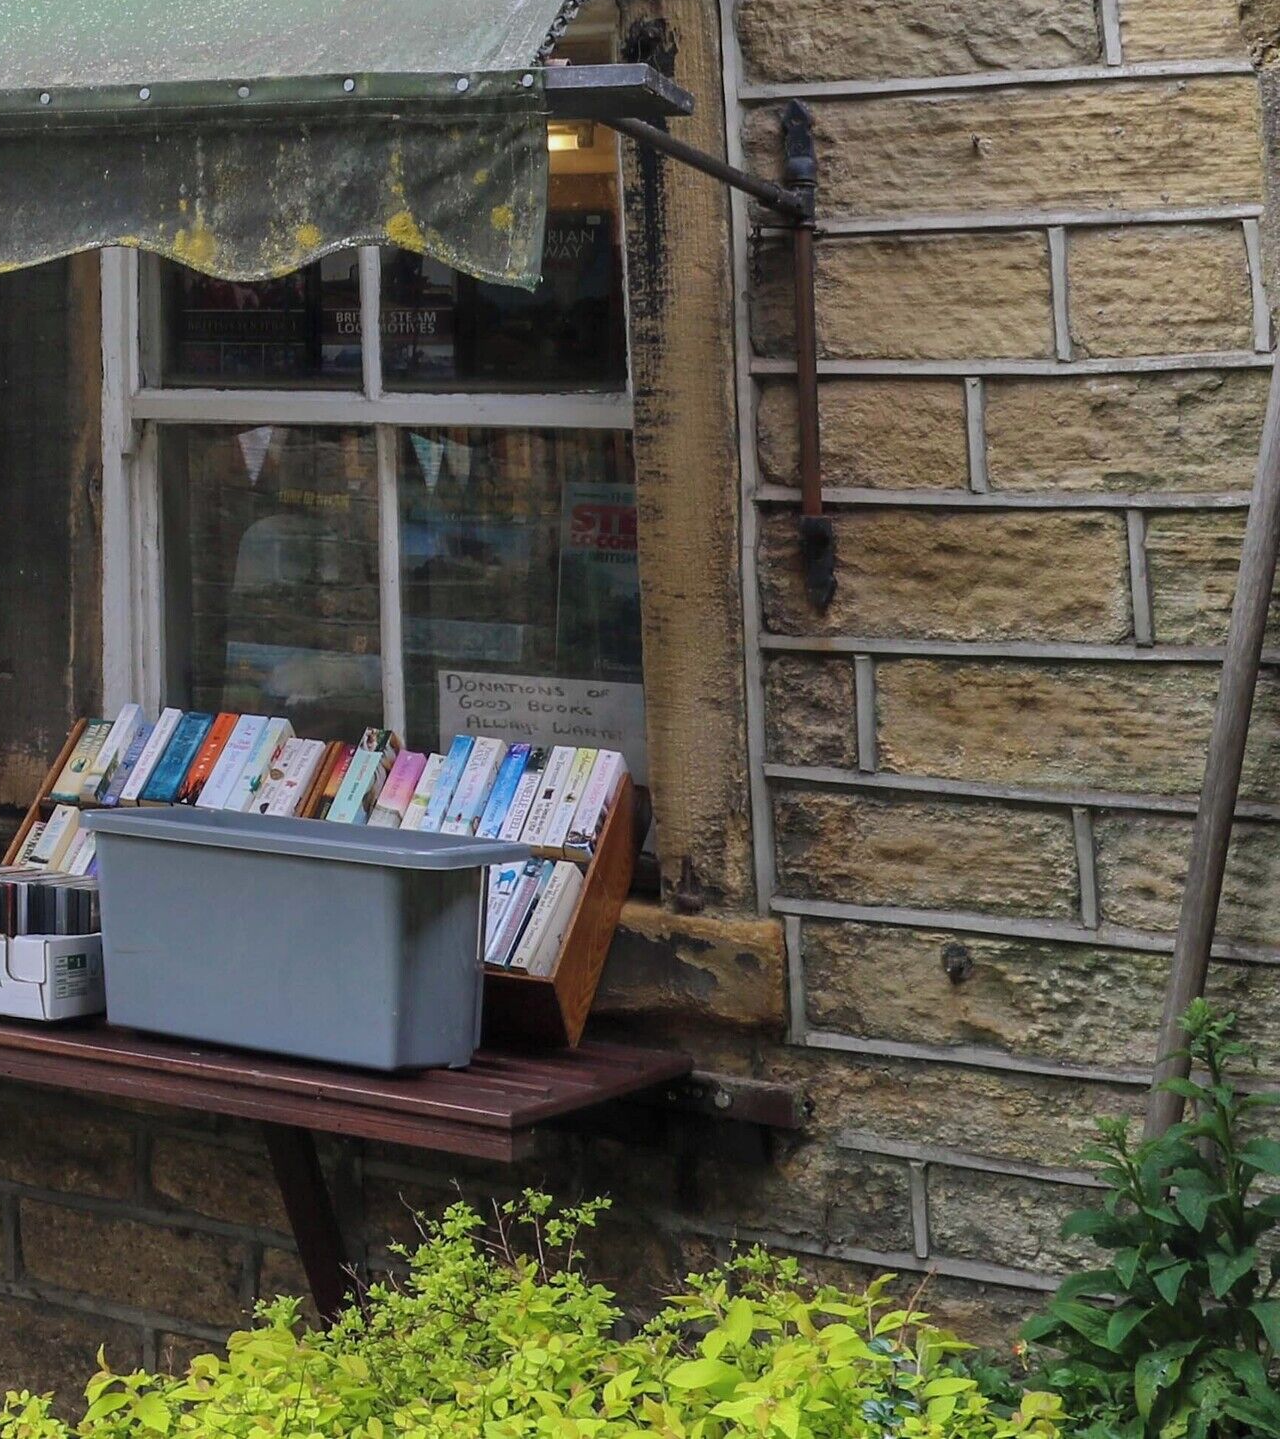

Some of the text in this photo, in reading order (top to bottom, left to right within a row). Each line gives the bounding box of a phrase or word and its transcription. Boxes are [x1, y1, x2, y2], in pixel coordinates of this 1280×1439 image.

[336, 311, 437, 323] BRIT STEAM
[338, 322, 435, 334] LOCMOTIVES
[446, 674, 611, 698] DONATIONS OF
[459, 694, 593, 716] GOOD BOOKS
[509, 775, 537, 830] DANIELLE STEEL
